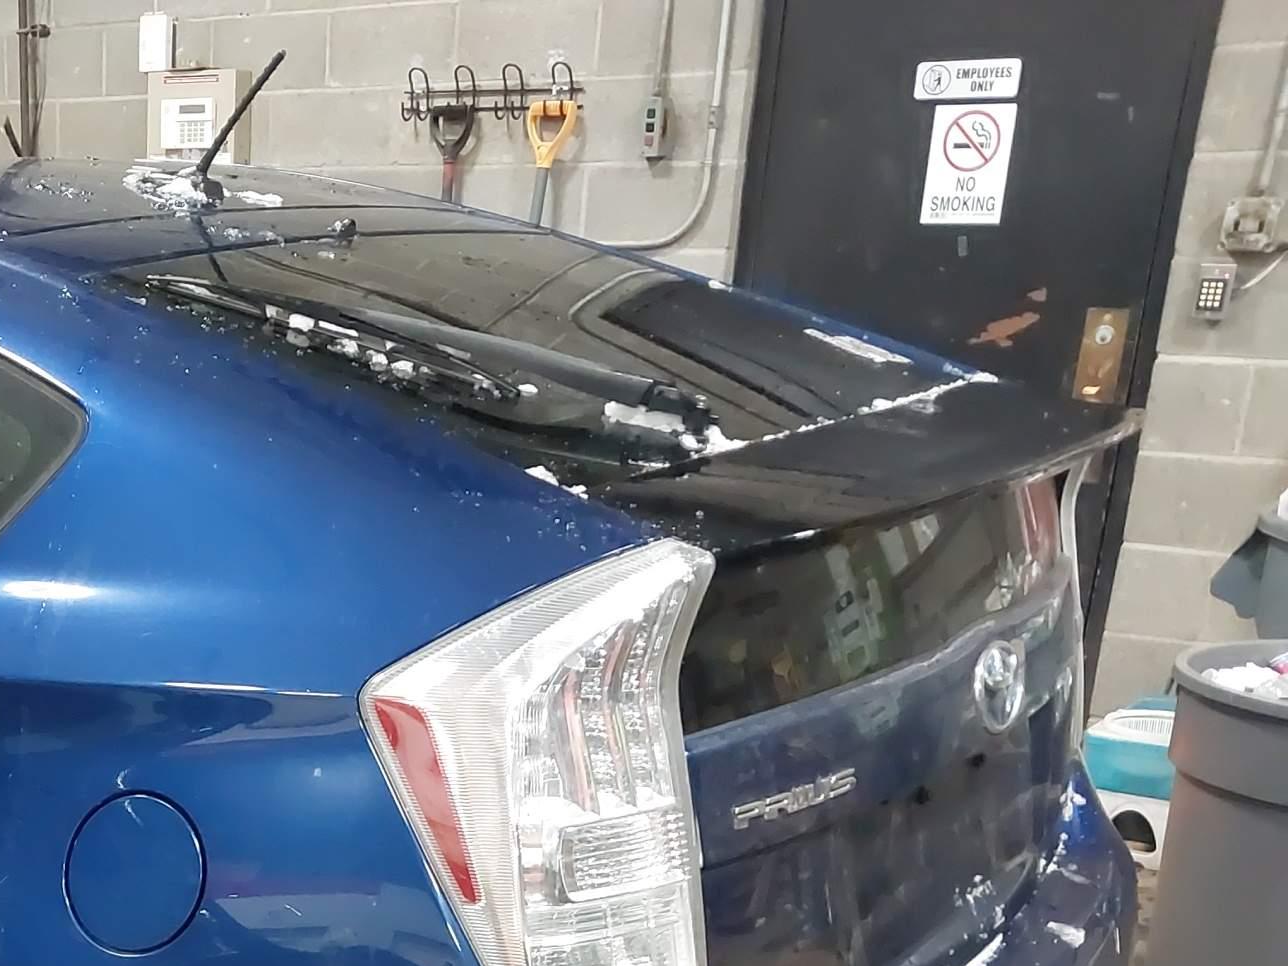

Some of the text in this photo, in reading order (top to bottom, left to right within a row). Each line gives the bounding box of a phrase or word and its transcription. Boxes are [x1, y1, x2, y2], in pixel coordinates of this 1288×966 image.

[956, 66, 1013, 80] EMPLOYEES
[970, 80, 995, 93] ONLY
[955, 176, 976, 192] NO
[929, 196, 996, 212] SMOKING
[731, 767, 857, 830] PRIUS
